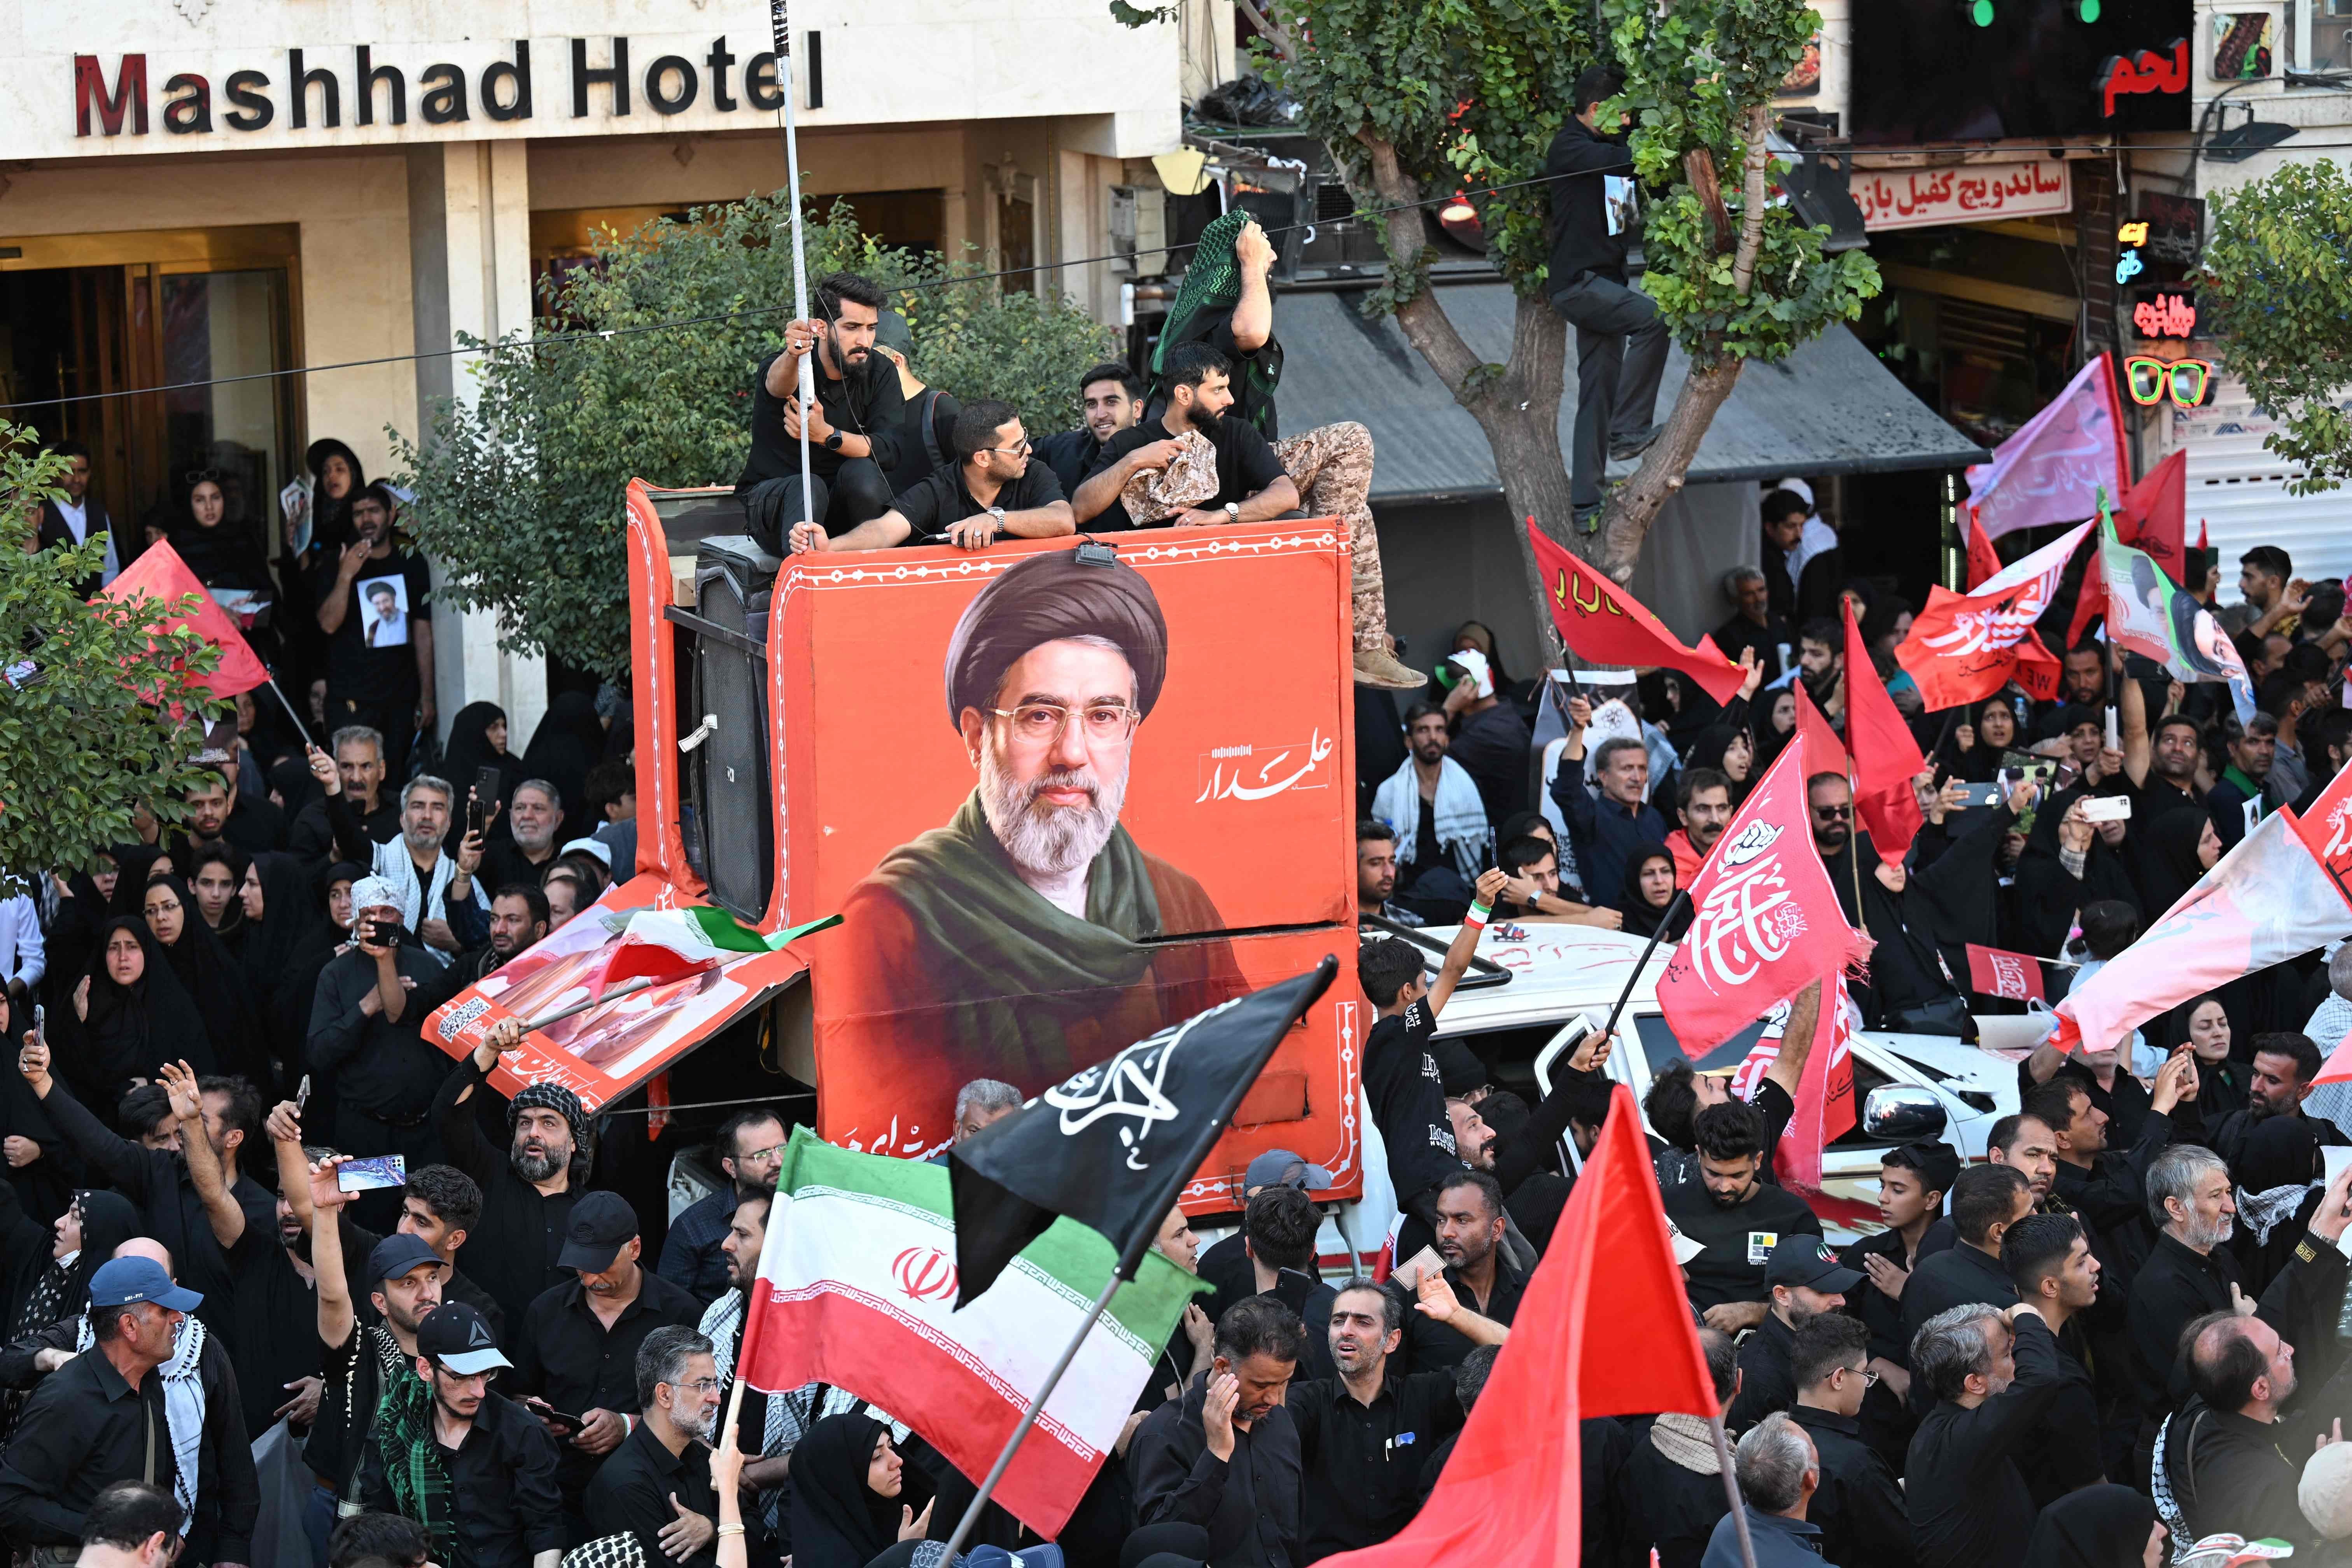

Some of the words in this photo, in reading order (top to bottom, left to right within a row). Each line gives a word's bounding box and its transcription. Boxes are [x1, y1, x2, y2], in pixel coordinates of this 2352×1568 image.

[74, 38, 534, 137] Mashhad
[572, 30, 824, 118] Hotel
[1958, 162, 2061, 210] ساندویچ
[124, 1293, 143, 1301] DRI-FIT
